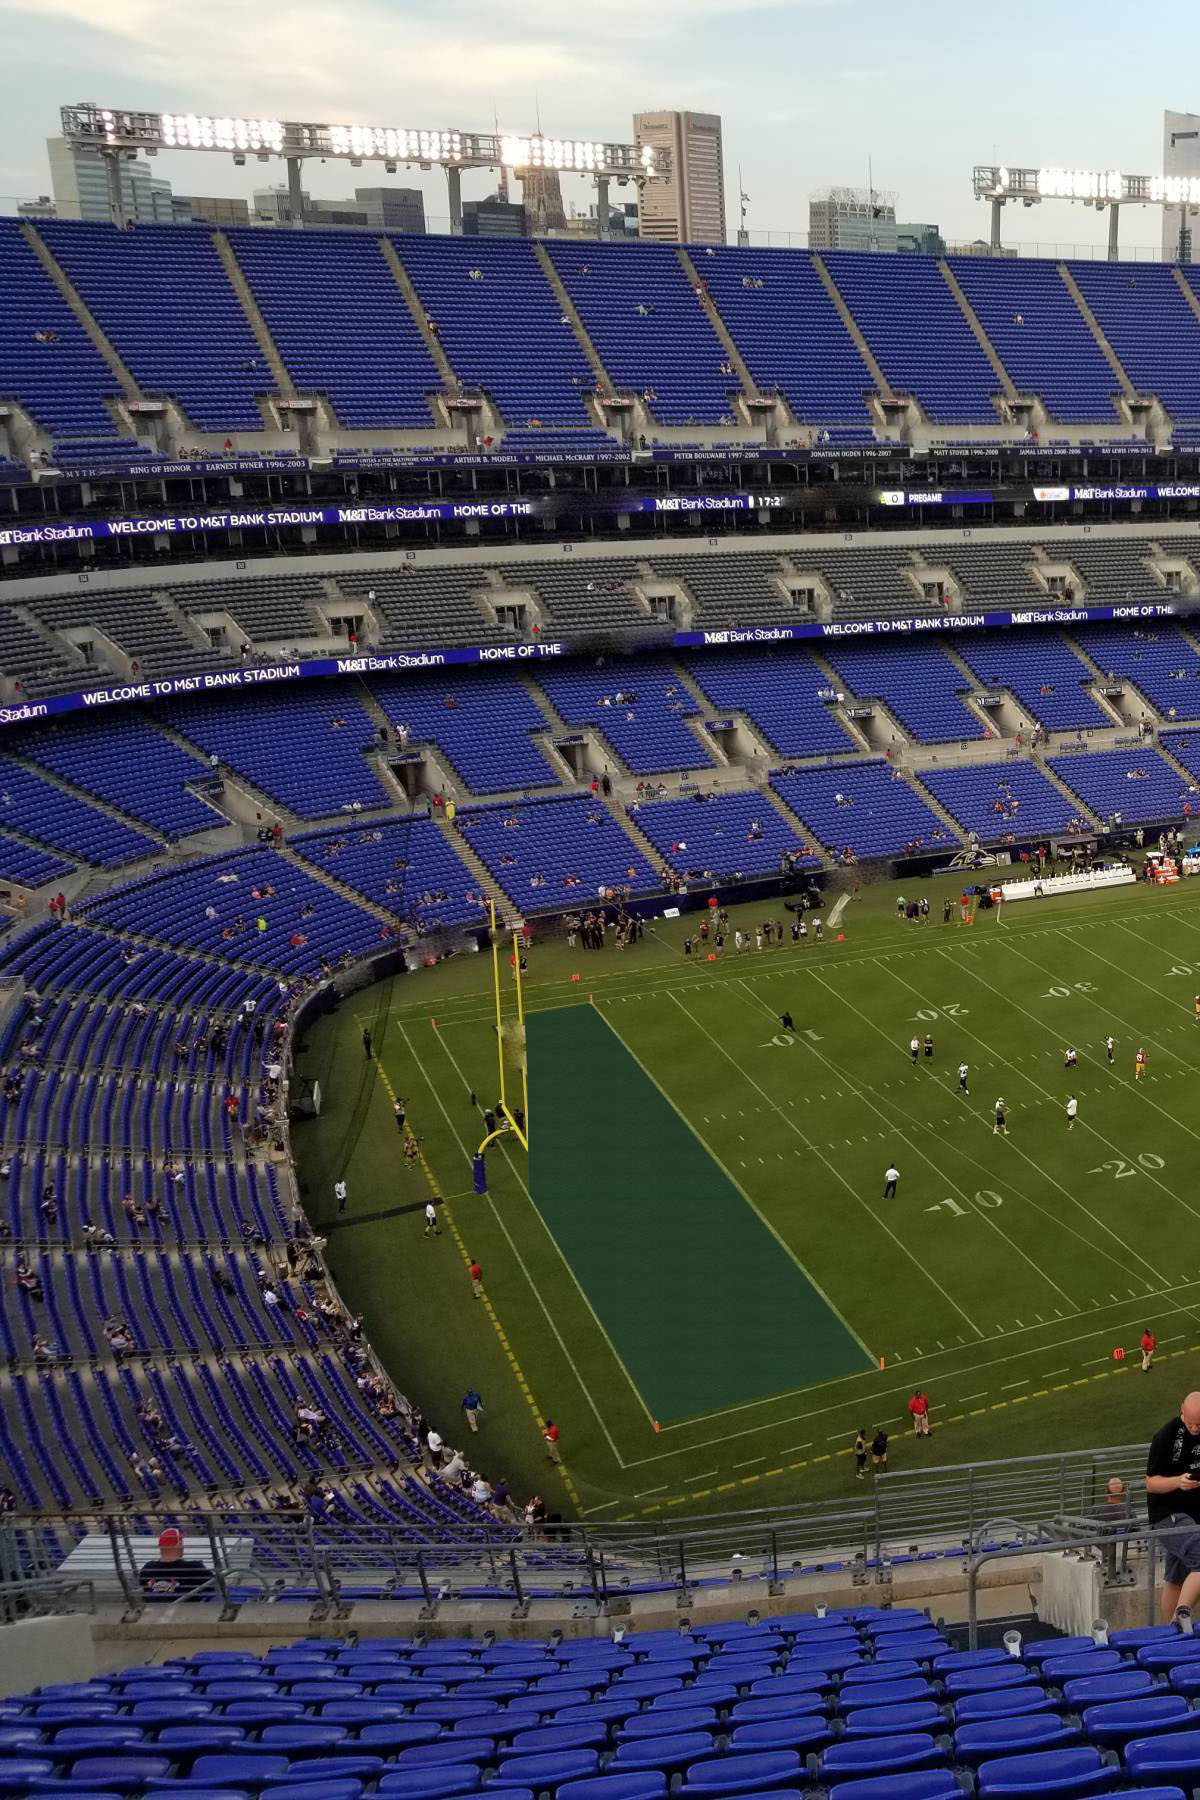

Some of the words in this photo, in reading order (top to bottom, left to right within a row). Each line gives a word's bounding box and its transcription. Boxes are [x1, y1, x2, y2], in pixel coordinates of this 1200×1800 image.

[454, 455, 479, 464] ARTHUR
[491, 454, 518, 463] MODELL
[535, 453, 563, 462] MICHAEL
[597, 452, 630, 461] 1997-2002
[674, 452, 693, 460] PETER
[60, 469, 95, 478] SMYTH
[130, 465, 150, 475] RING
[152, 465, 162, 474] OF
[163, 464, 191, 473] HONOR
[206, 462, 238, 471] EARNEST
[239, 461, 263, 470] BYNER
[265, 460, 306, 469] 1996-2003
[909, 493, 942, 503] PREGAME
[1074, 488, 1095, 498] M&T
[1095, 488, 1115, 498] Bank
[1115, 486, 1147, 498] Stadium
[1158, 486, 1200, 497] WELCOME
[454, 505, 489, 516] HOME
[491, 504, 507, 515] OF
[656, 499, 680, 510] M&T
[681, 498, 705, 510] Bank
[705, 497, 743, 510] Stadium
[338, 508, 368, 522] M&T
[368, 507, 394, 520] Bank
[395, 506, 441, 520] Stadium
[108, 519, 176, 534] WELCOME
[178, 518, 198, 529] TO
[200, 516, 227, 528] M&T
[230, 514, 264, 526] BANK
[268, 511, 323, 525] STADIUM
[14, 529, 44, 542] Bank
[44, 526, 92, 540] Stadium
[1011, 612, 1034, 623] M&T
[1034, 611, 1054, 622] Bank
[1054, 610, 1088, 621] Stadium
[1112, 606, 1139, 618] HOME
[1140, 606, 1154, 616] OF
[823, 622, 874, 634] WELCOME
[876, 621, 890, 631] TO
[892, 620, 912, 630] M&T
[915, 618, 942, 629] BANK
[943, 616, 984, 628] STADIUM
[704, 632, 730, 644] M&T
[730, 630, 754, 642] Bank
[754, 628, 792, 641] Stadium
[480, 647, 516, 660] HOME
[518, 646, 535, 657] OF
[538, 644, 561, 655] THE
[337, 658, 368, 673] M&T
[368, 656, 398, 670] Bank
[398, 653, 444, 668] Stadium
[82, 684, 150, 705] WELCOME
[152, 682, 172, 694] TO
[174, 677, 200, 692] M&T
[205, 672, 240, 688] BANK
[244, 666, 300, 684] STADIUM
[0, 704, 47, 722] Stadium
[1048, 981, 1099, 999] 30
[915, 1002, 969, 1021] 20
[770, 1028, 825, 1047] 10
[1101, 1152, 1166, 1179] 20
[938, 1190, 1003, 1217] 10
